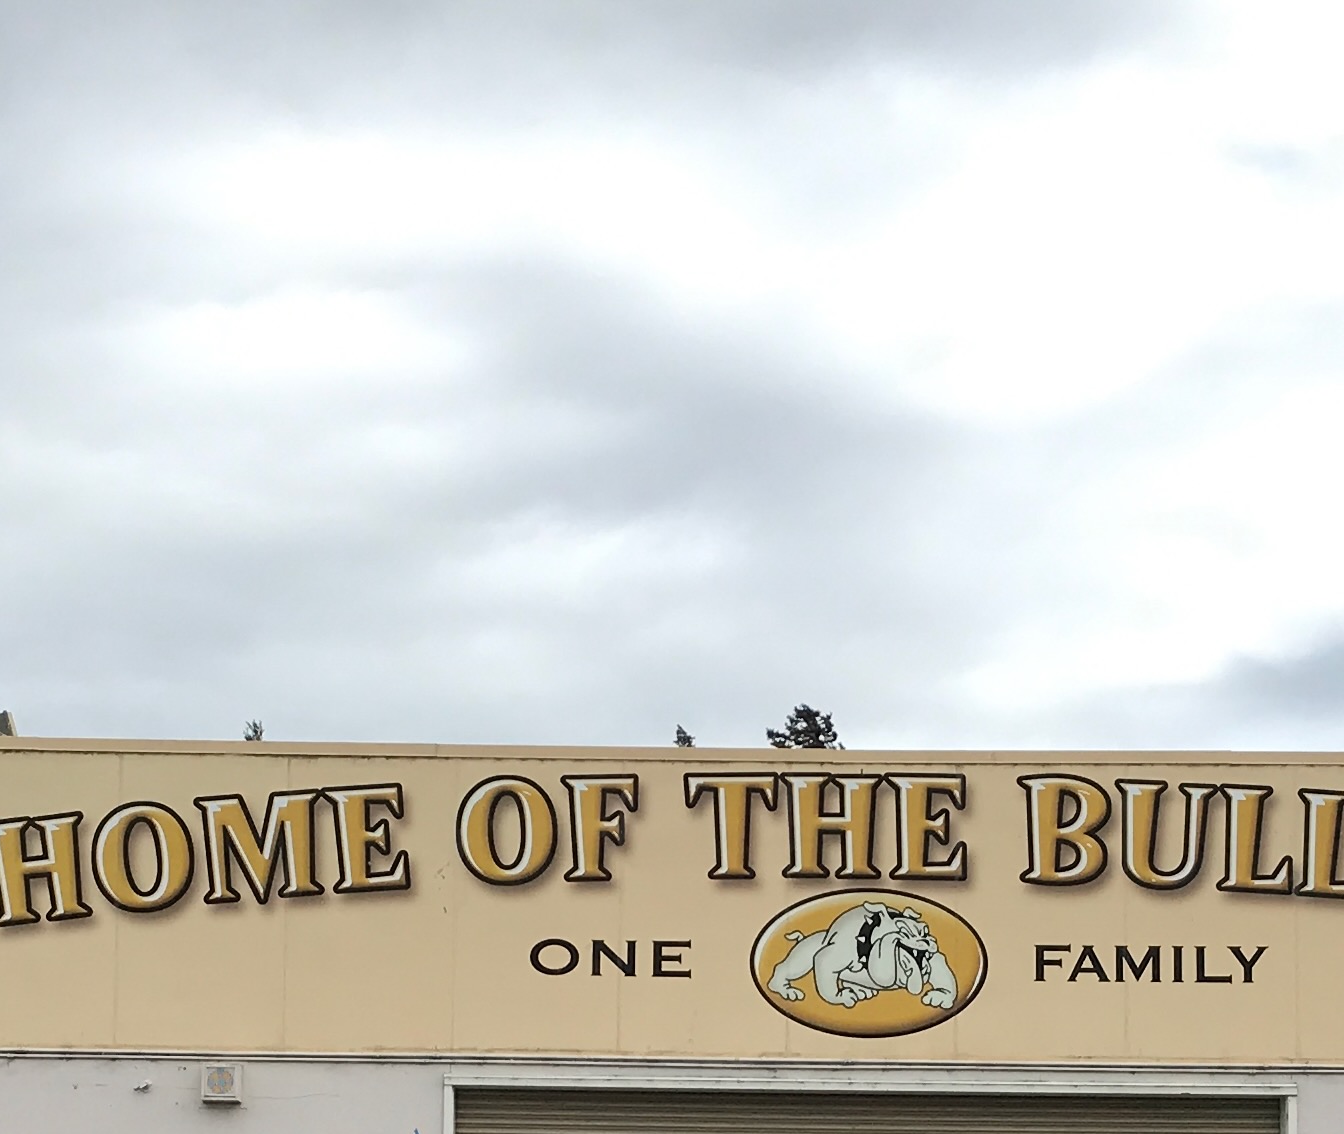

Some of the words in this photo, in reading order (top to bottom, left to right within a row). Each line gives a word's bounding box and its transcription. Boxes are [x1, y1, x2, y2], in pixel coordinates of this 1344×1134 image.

[456, 774, 639, 886] OF
[684, 773, 968, 882] THE
[529, 938, 693, 979] ONE
[1032, 943, 1270, 985] FAMILY
